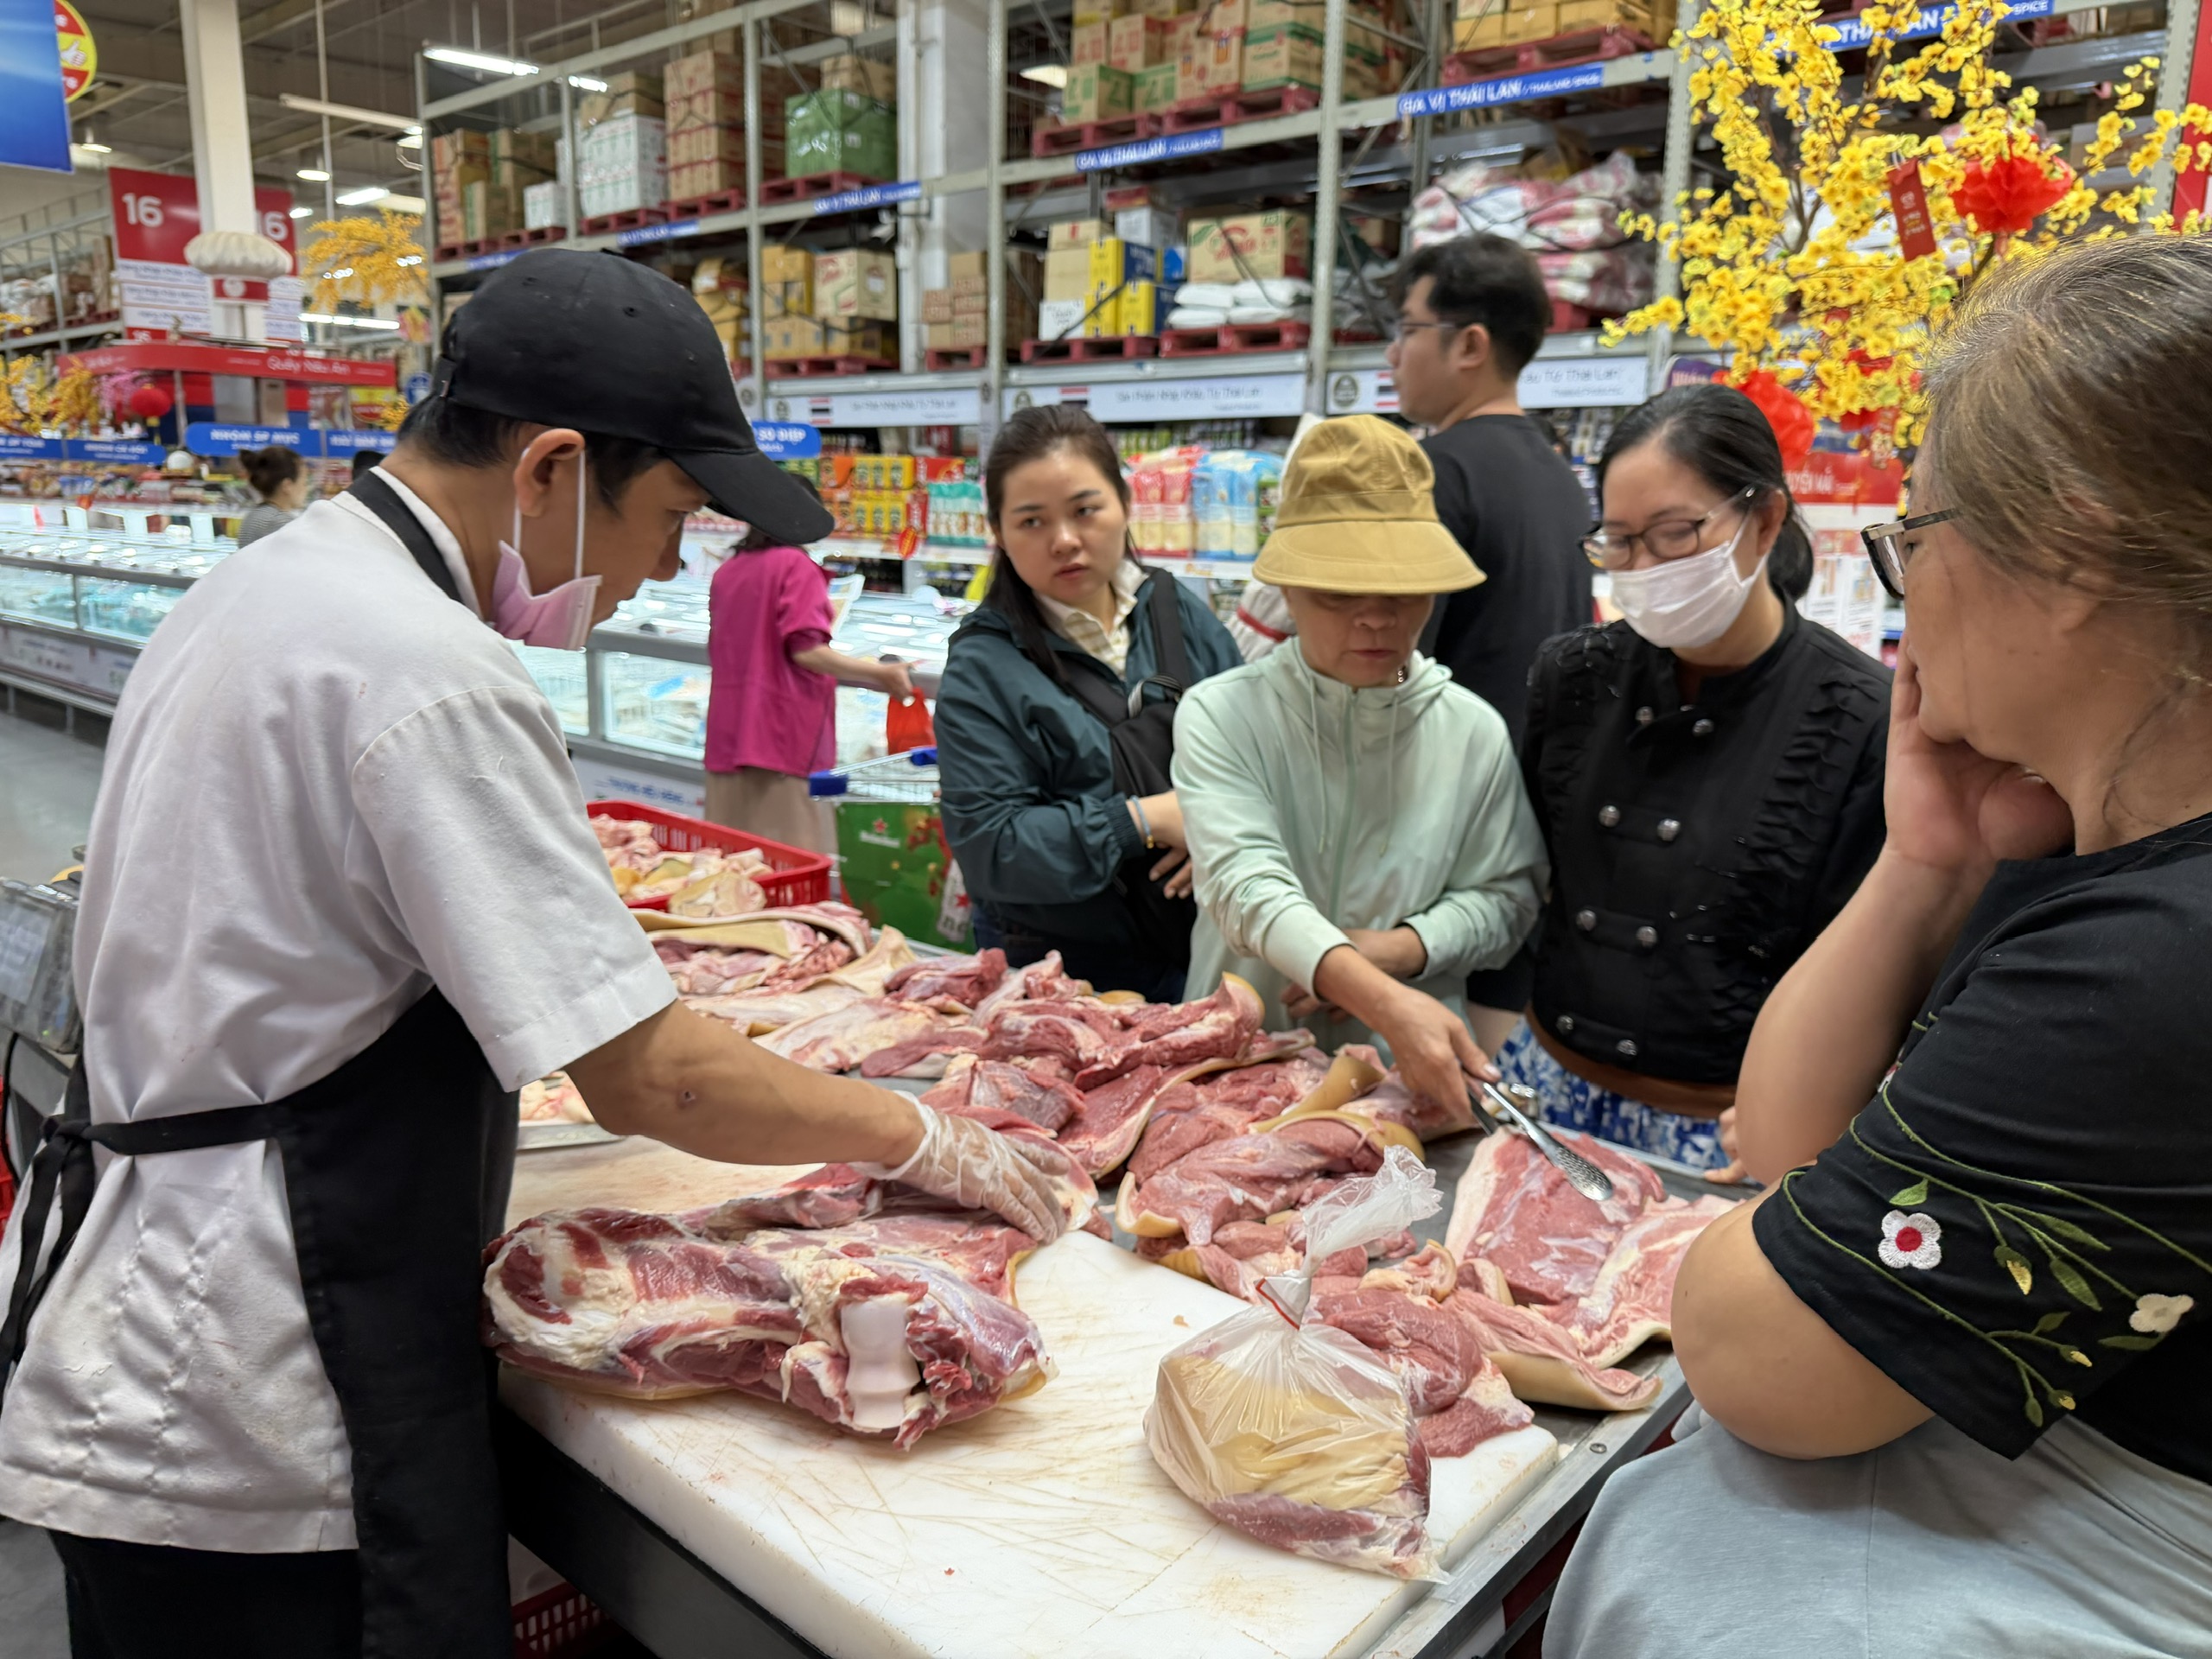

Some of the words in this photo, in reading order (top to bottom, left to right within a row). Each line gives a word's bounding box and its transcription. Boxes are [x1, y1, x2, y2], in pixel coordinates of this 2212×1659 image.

[2012, 1, 2049, 16] SPICE
[1486, 79, 1522, 103] LAN
[122, 192, 164, 228] 16
